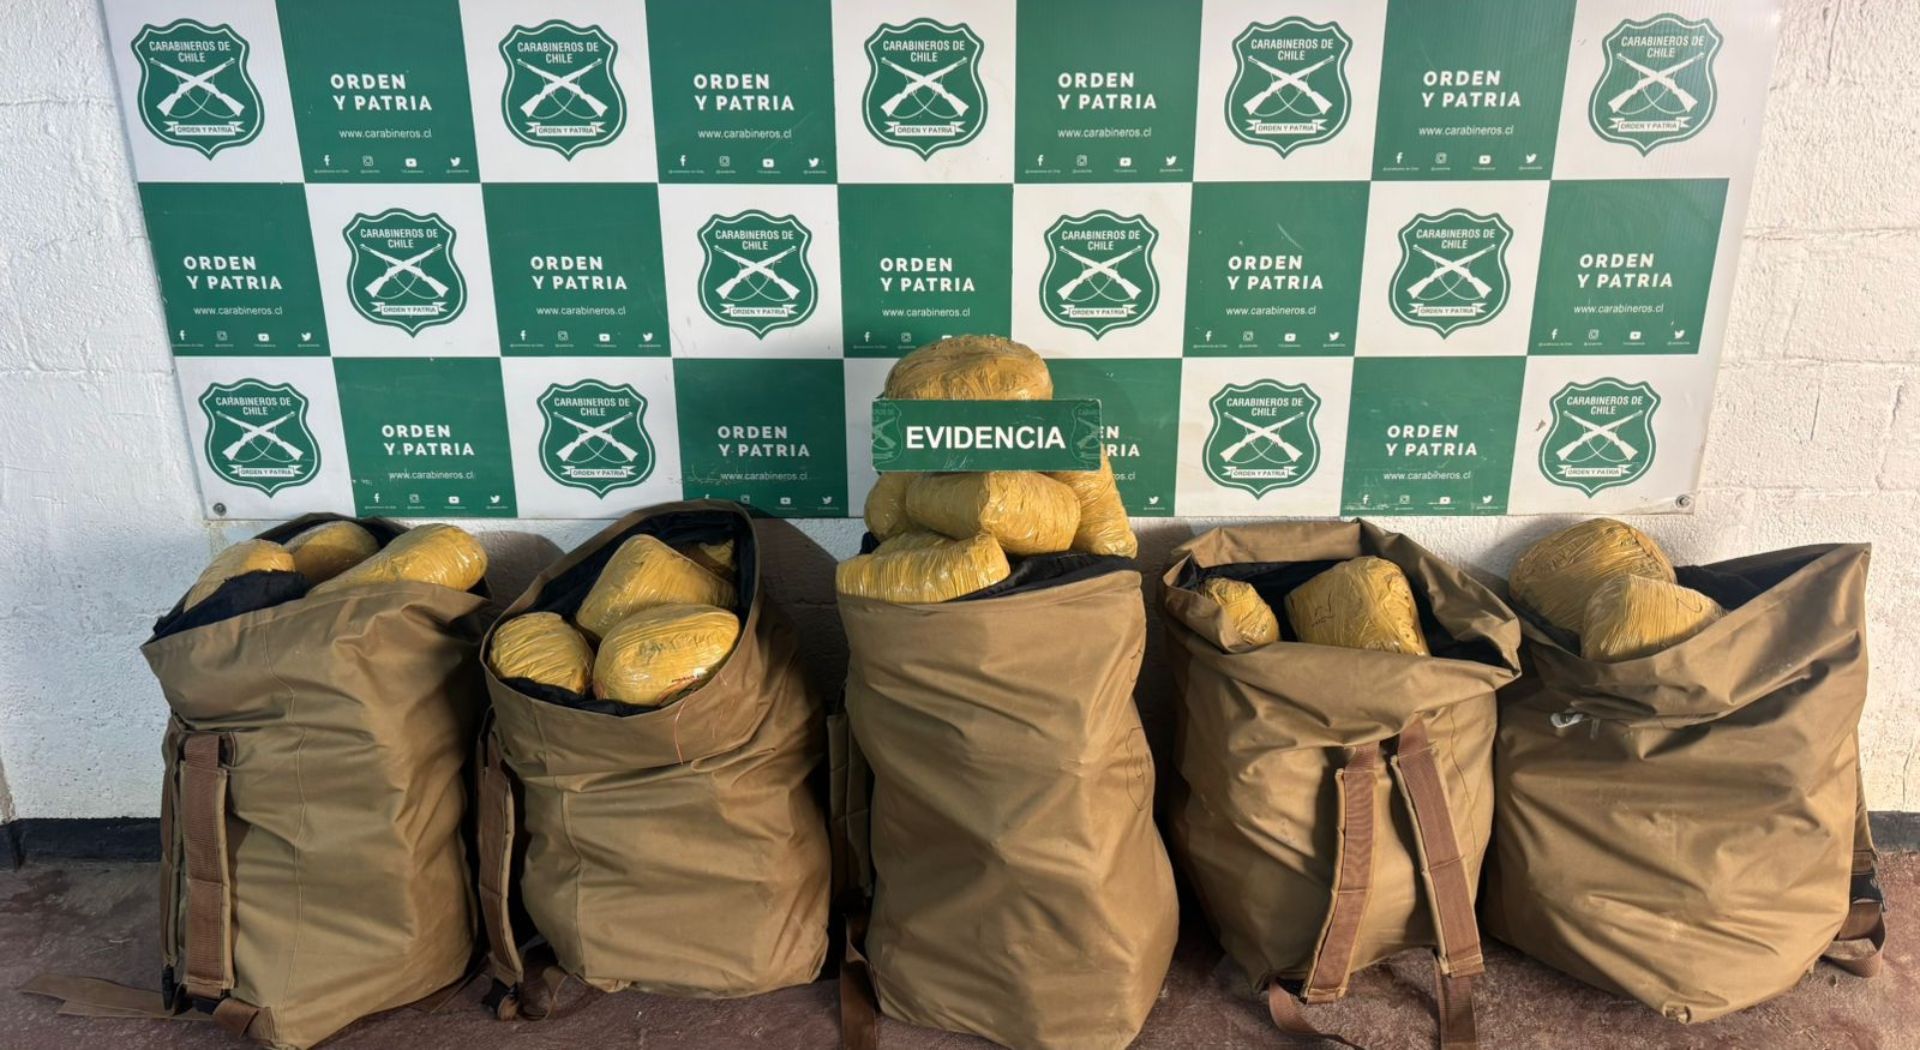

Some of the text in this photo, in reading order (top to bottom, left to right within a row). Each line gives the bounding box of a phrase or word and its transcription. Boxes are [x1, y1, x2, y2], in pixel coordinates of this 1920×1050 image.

[149, 41, 230, 51] CARABINEROS DE
[883, 40, 964, 51] CARABINEROS DE
[1251, 39, 1333, 49] CARABINEROS DE
[1621, 35, 1704, 47] CARABINEROS DE
[517, 42, 599, 52] CARABINEROS DE
[178, 52, 205, 62] CHILE
[911, 52, 937, 62] CHILE
[1278, 50, 1305, 60] CHILE
[1647, 47, 1675, 58] CHILE
[546, 53, 572, 63] CHILE
[331, 74, 405, 89] ORDEN
[694, 74, 769, 89] ORDEN
[1058, 73, 1134, 88] ORDEN
[1424, 70, 1500, 86] ORDEN
[333, 95, 432, 110] Y PATRIA
[695, 95, 794, 110] Y PATRIA
[1058, 94, 1156, 109] Y PATRIA
[1422, 92, 1520, 107] Y PATRIA
[339, 129, 432, 138] www.carabineros.cl
[698, 129, 791, 139] www.carabineros.cl
[1058, 128, 1151, 138] www.carabineros.cl
[1419, 125, 1514, 136] www.carabineros.cl
[360, 229, 438, 238] CARABINEROS DE
[715, 230, 793, 240] CARABINEROS DE
[1062, 230, 1140, 240] CARABINEROS DE
[1416, 229, 1495, 239] CARABINEROS DE
[388, 239, 413, 248] CHILE
[742, 240, 768, 250] CHILE
[1088, 241, 1114, 250] CHILE
[1441, 239, 1468, 249] CHILE
[184, 256, 256, 270] ORDEN
[531, 256, 602, 270] ORDEN
[880, 258, 952, 272] ORDEN
[1229, 255, 1302, 270] ORDEN
[1580, 253, 1654, 268] ORDEN
[187, 276, 282, 289] Y PATRIA
[532, 276, 627, 289] Y PATRIA
[881, 277, 975, 291] Y PATRIA
[1228, 275, 1323, 290] Y PATRIA
[1578, 273, 1672, 288] Y PATRIA
[193, 306, 282, 315] www.carabineros.cl
[536, 306, 626, 315] www.carabineros.cl
[882, 308, 970, 317] www.carabineros.cl
[1226, 306, 1316, 315] www.carabineros.cl
[1574, 304, 1664, 313] www.carabineros.cl
[216, 397, 291, 407] CARABINEROS DE
[554, 398, 630, 407] CARABINEROS DE
[1227, 398, 1303, 407] CARABINEROS DE
[1567, 396, 1643, 406] CARABINEROS DE
[242, 406, 268, 416] CHILE
[580, 407, 605, 416] CHILE
[1251, 407, 1277, 416] CHILE
[1590, 406, 1616, 415] CHILE
[382, 425, 450, 437] ORDEN
[718, 426, 787, 439] ORDEN
[1387, 425, 1458, 438] ORDEN
[907, 426, 1066, 449] EVIDENCIA
[384, 443, 474, 455] Y PATRIA
[719, 444, 809, 456] Y PATRIA
[1107, 443, 1140, 457] RIA
[1386, 443, 1477, 456] Y PATRIA
[389, 471, 474, 480] www.carabineros.cl
[720, 471, 808, 481] www.carabineros.cl
[1384, 471, 1471, 480] www.carabineros.cl
